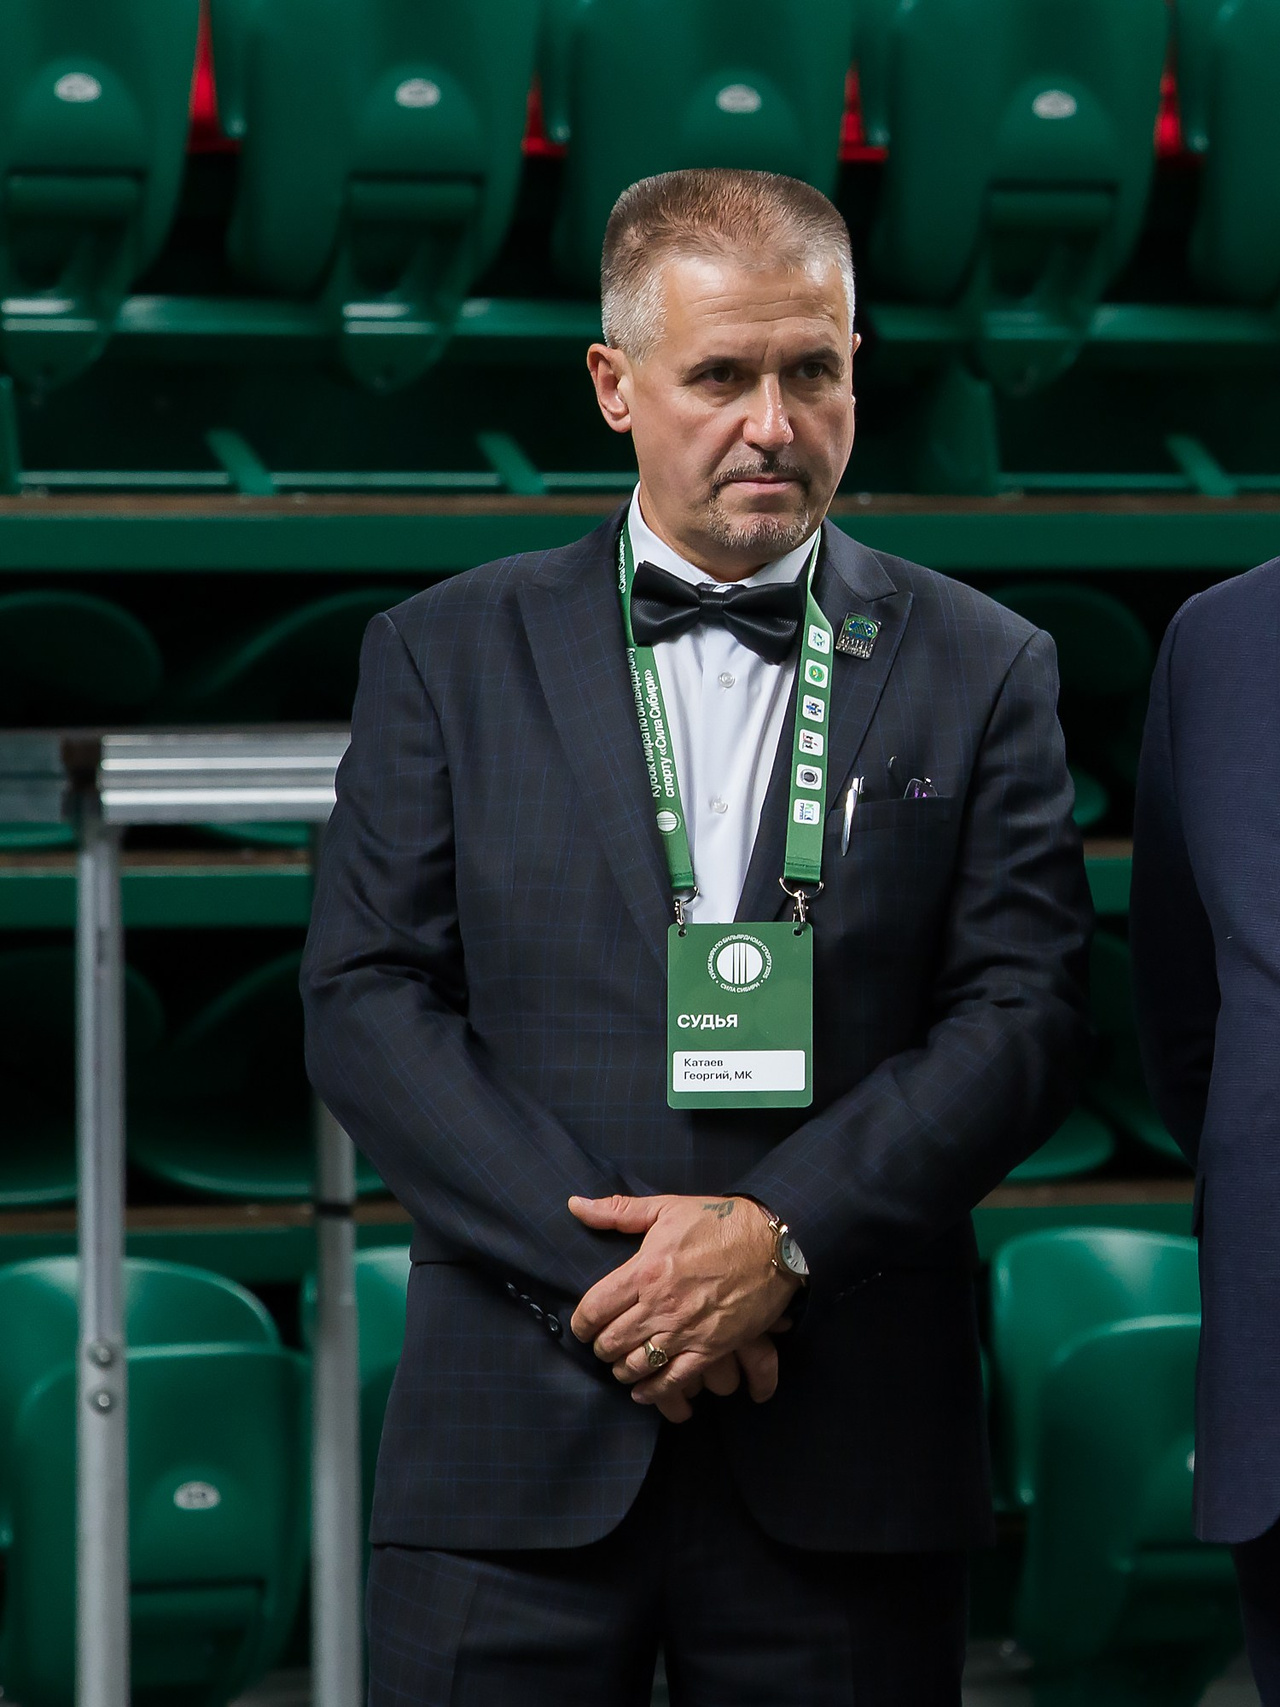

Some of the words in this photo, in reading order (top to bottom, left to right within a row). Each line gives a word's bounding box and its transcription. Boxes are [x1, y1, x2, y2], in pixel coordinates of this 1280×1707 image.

[644, 669, 660, 719] Сибири»
[638, 717, 650, 732] по
[641, 731, 655, 762] мира
[652, 719, 667, 756] «Сила
[659, 757, 675, 798] спорту
[677, 1014, 738, 1030] СУДЬЯ
[684, 1058, 723, 1067] Катаев
[684, 1070, 732, 1081] Георгий,
[734, 1070, 753, 1080] МК
